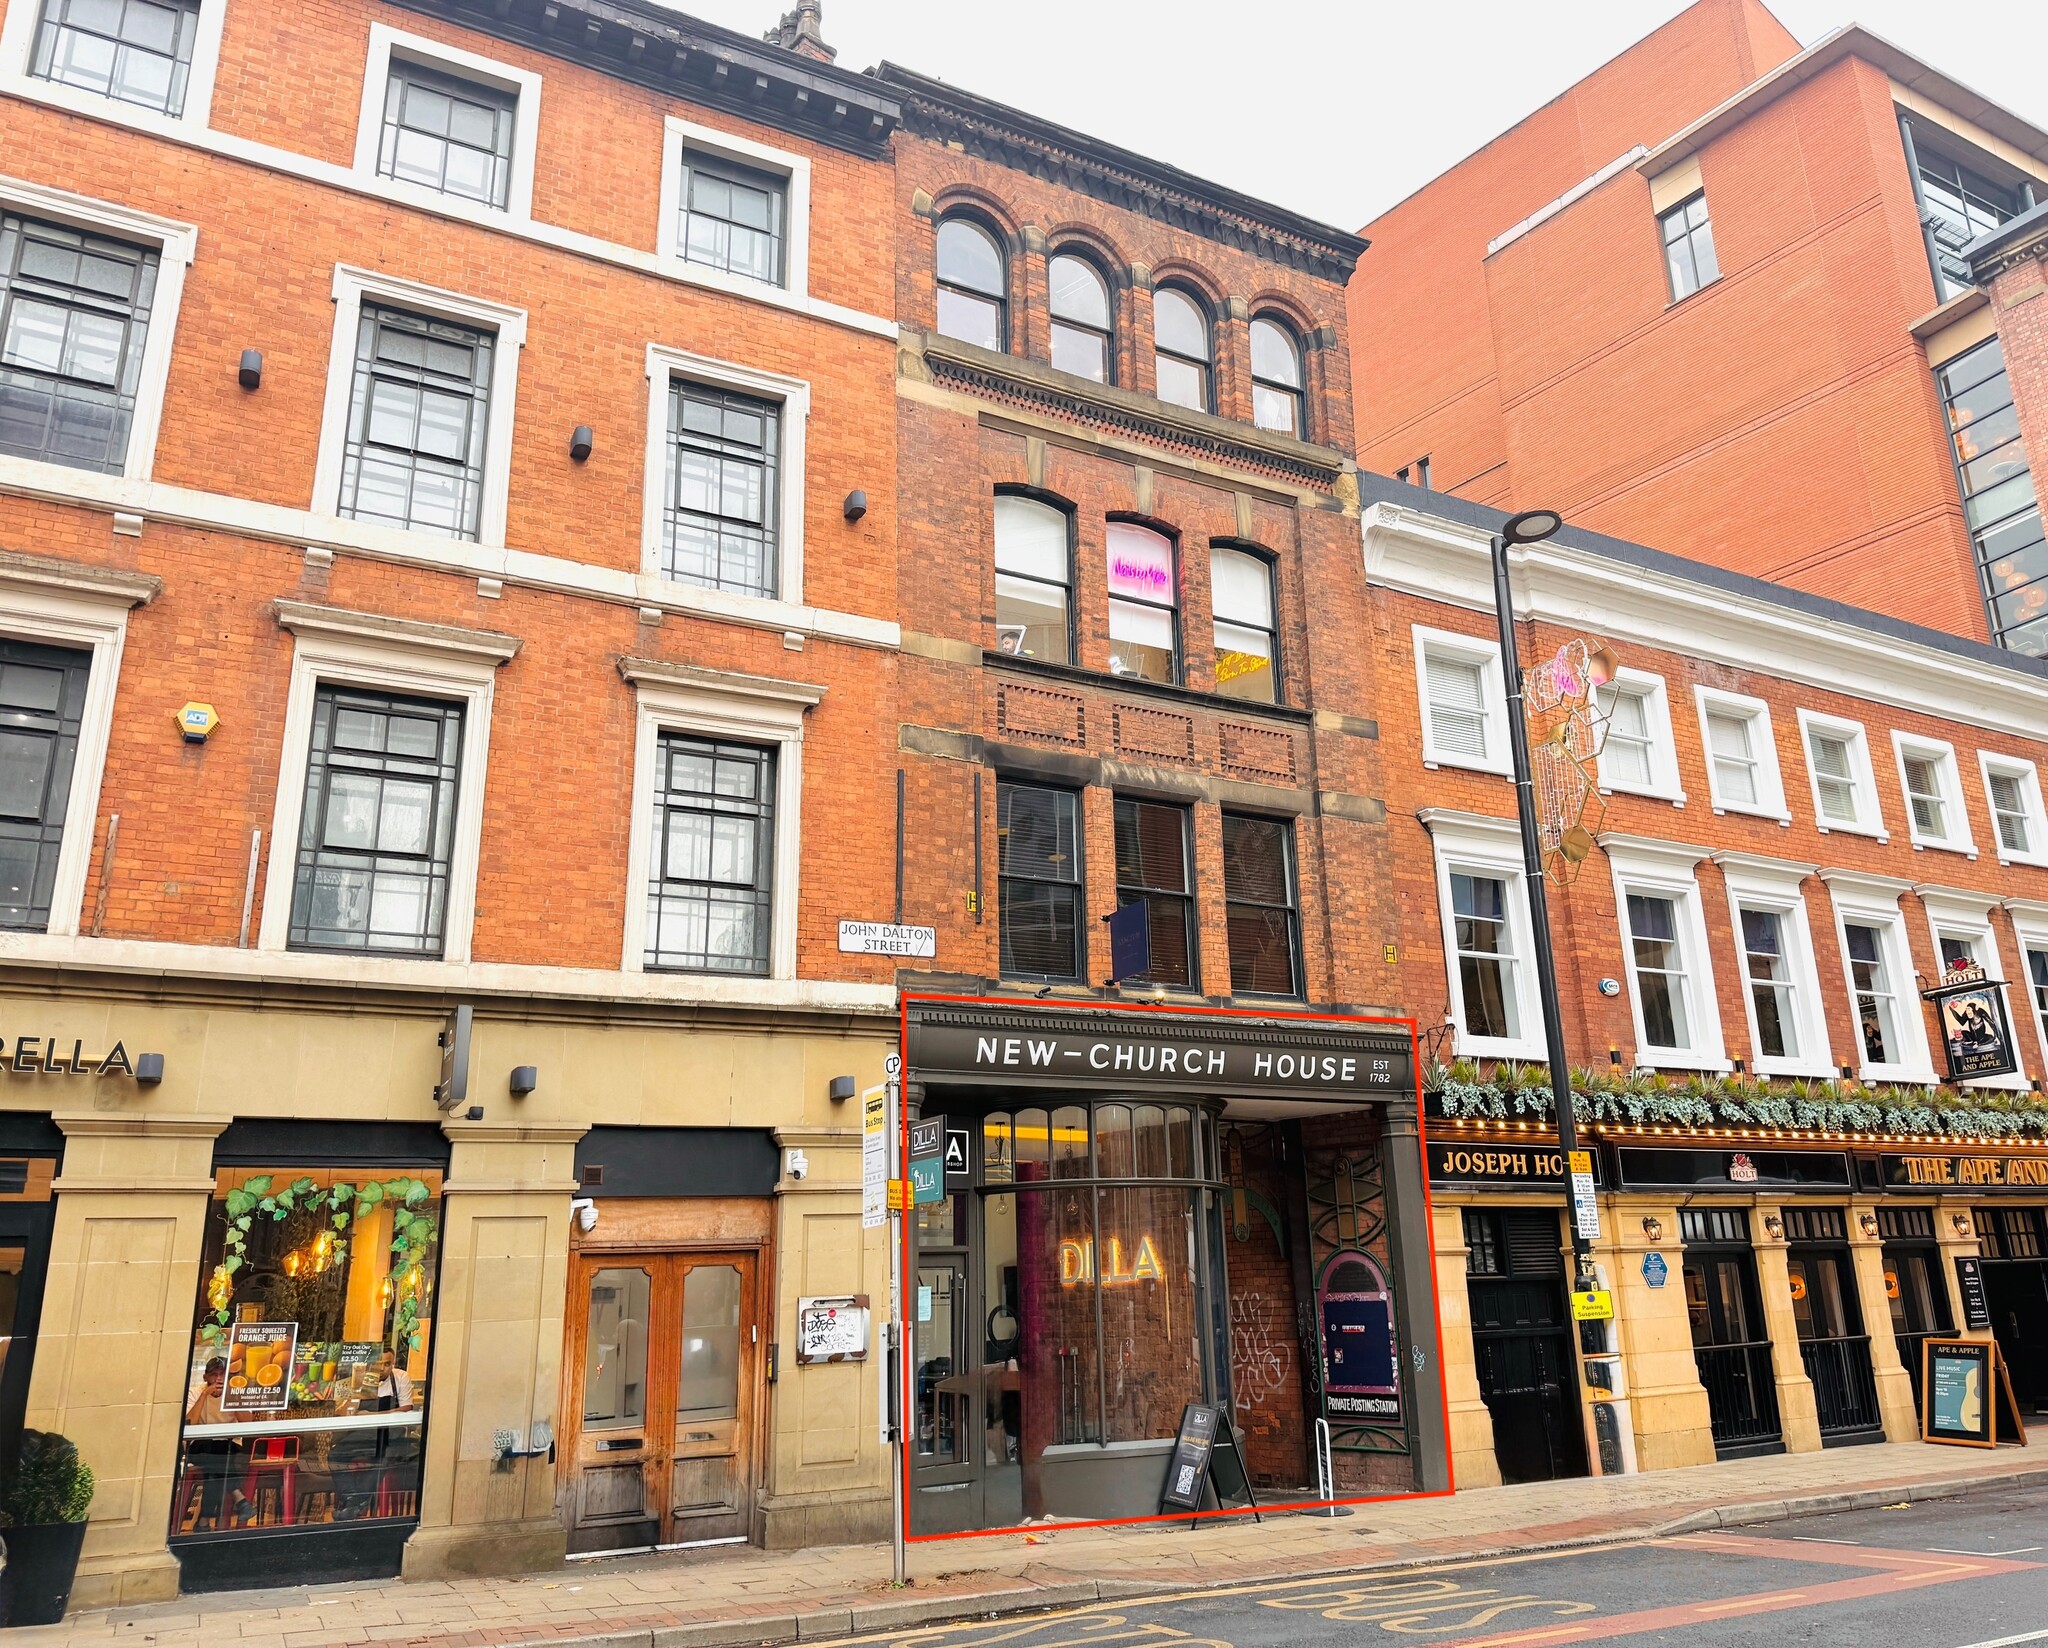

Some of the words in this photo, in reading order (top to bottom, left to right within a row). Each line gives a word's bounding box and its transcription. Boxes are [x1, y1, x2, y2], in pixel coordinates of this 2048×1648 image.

[842, 924, 877, 936] JOHN
[882, 926, 933, 940] DALTON
[864, 939, 911, 952] STREET
[1945, 971, 1981, 986] HOLT
[0, 1036, 135, 1077] ELLA
[886, 1056, 900, 1074] CP
[1373, 1060, 1389, 1070] EST
[1965, 1055, 1979, 1063] THE
[1981, 1052, 1995, 1061] APE
[1254, 1053, 1357, 1081] HOUSE
[1962, 1063, 1977, 1071] AND
[1979, 1060, 2001, 1069] APPLE
[1369, 1073, 1391, 1083] 1782
[913, 1127, 936, 1147] DILLA
[1443, 1152, 1528, 1175] JOSEPH
[1534, 1154, 1564, 1176] HO
[1902, 1157, 1954, 1184] THE
[1958, 1158, 2004, 1185] APE
[2007, 1159, 2048, 1185] AND
[916, 1172, 935, 1189] DILLA
[1732, 1170, 1756, 1178] HOLT
[1060, 1236, 1162, 1284] DILLA
[238, 1334, 266, 1342] ORANGE
[1328, 1396, 1351, 1411] PRIVATE
[1351, 1398, 1375, 1412] POSTING
[1375, 1398, 1398, 1413] STATION
[1256, 1580, 1597, 1634] BUS
